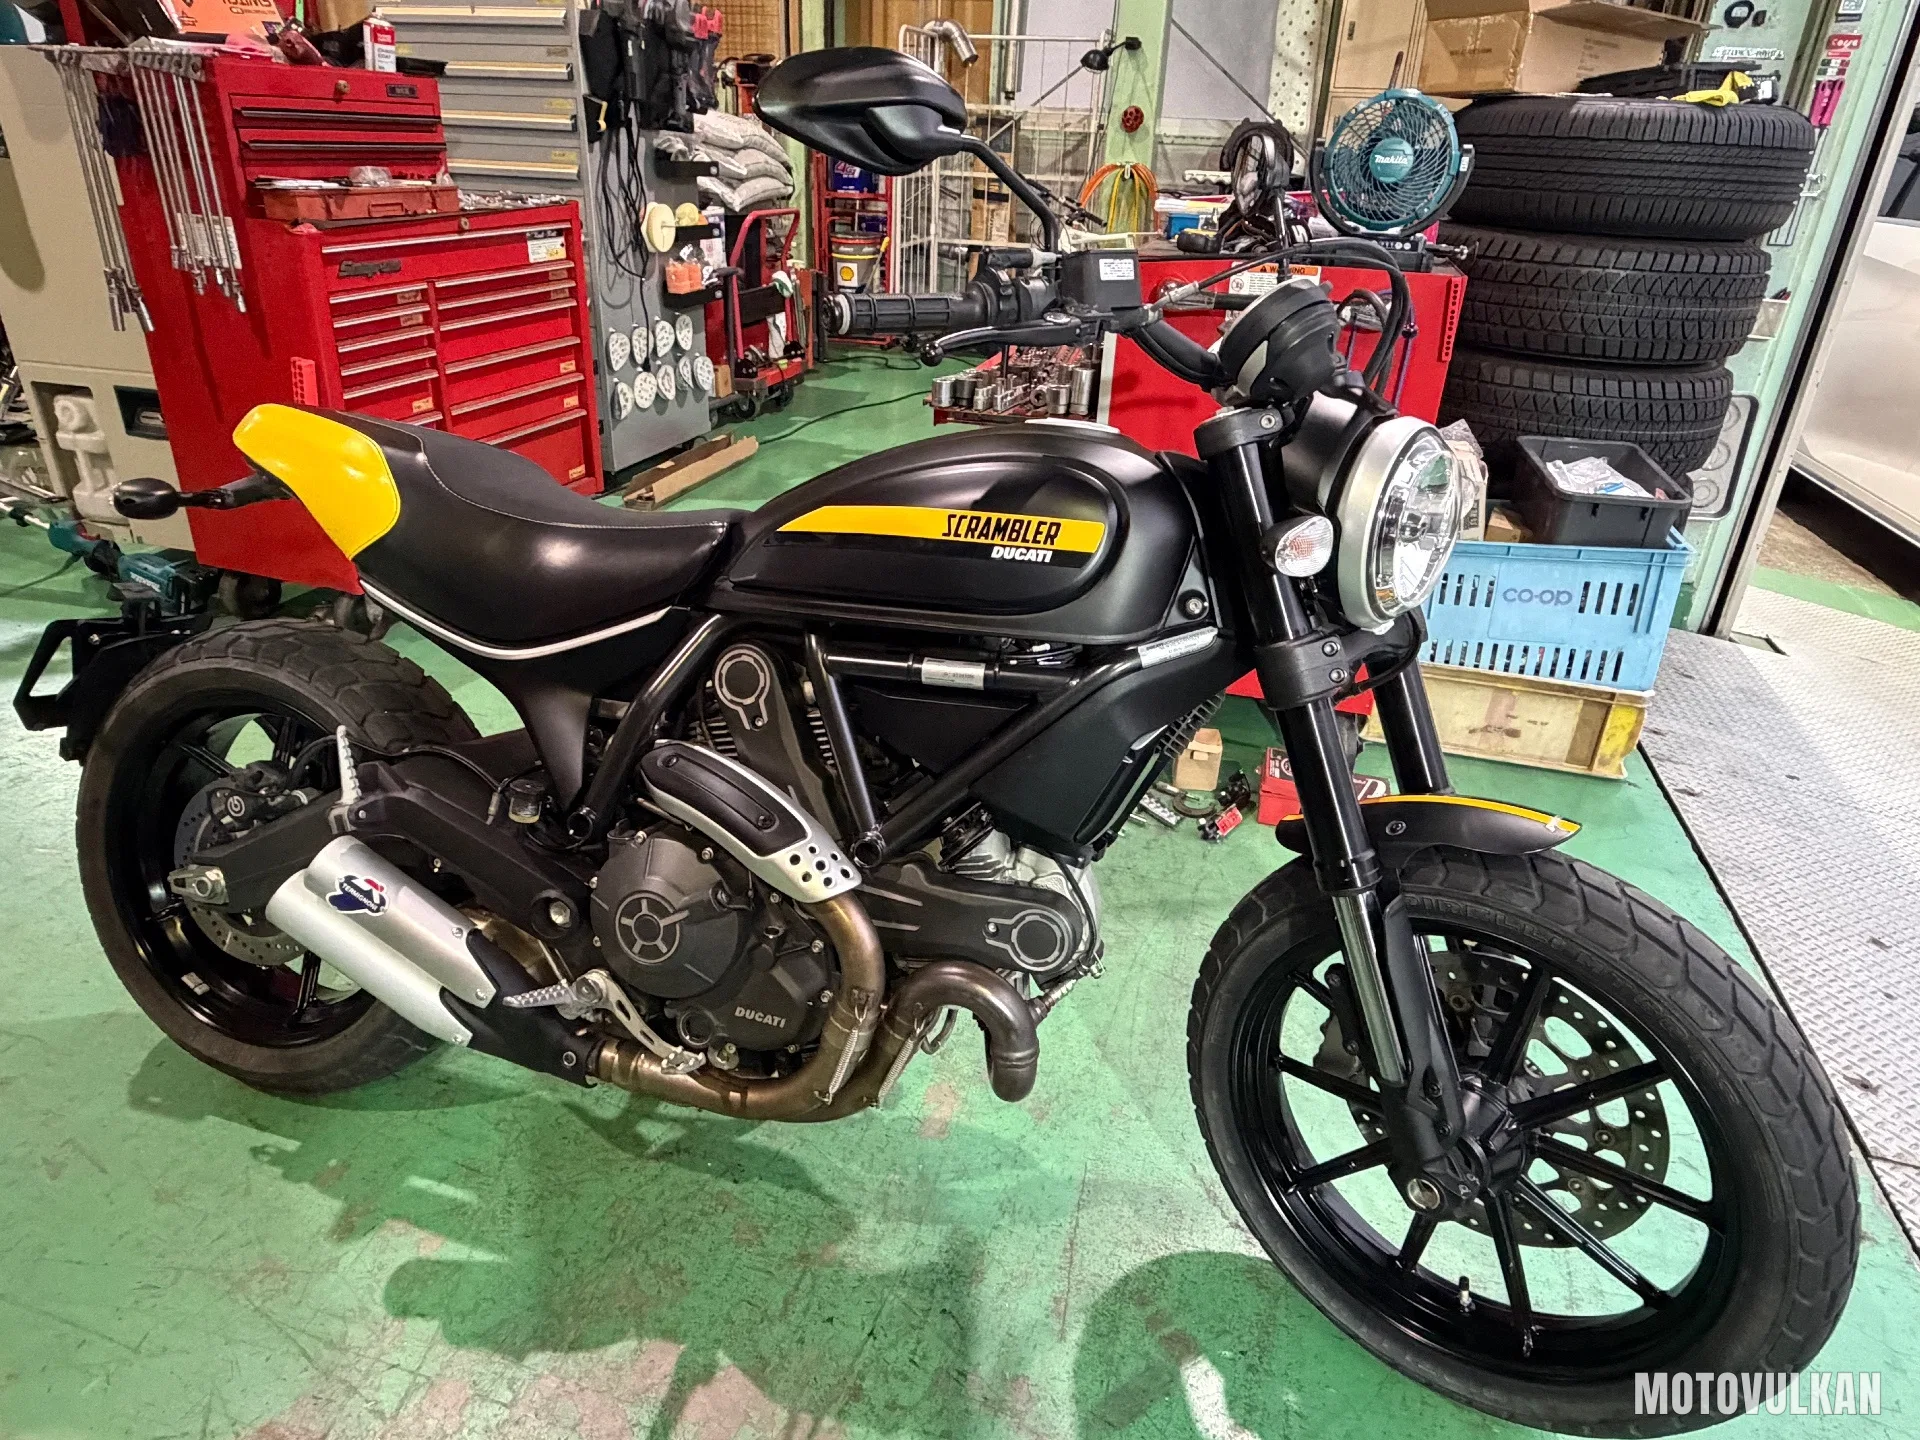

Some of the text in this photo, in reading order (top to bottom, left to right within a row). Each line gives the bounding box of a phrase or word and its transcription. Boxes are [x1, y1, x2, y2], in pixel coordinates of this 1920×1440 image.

[942, 514, 1062, 546] SCRAMBLER
[990, 545, 1053, 563] DUCATI
[1502, 587, 1573, 606] co-op
[342, 882, 378, 911] TERMIGNONI
[734, 1006, 787, 1028] DUCATI
